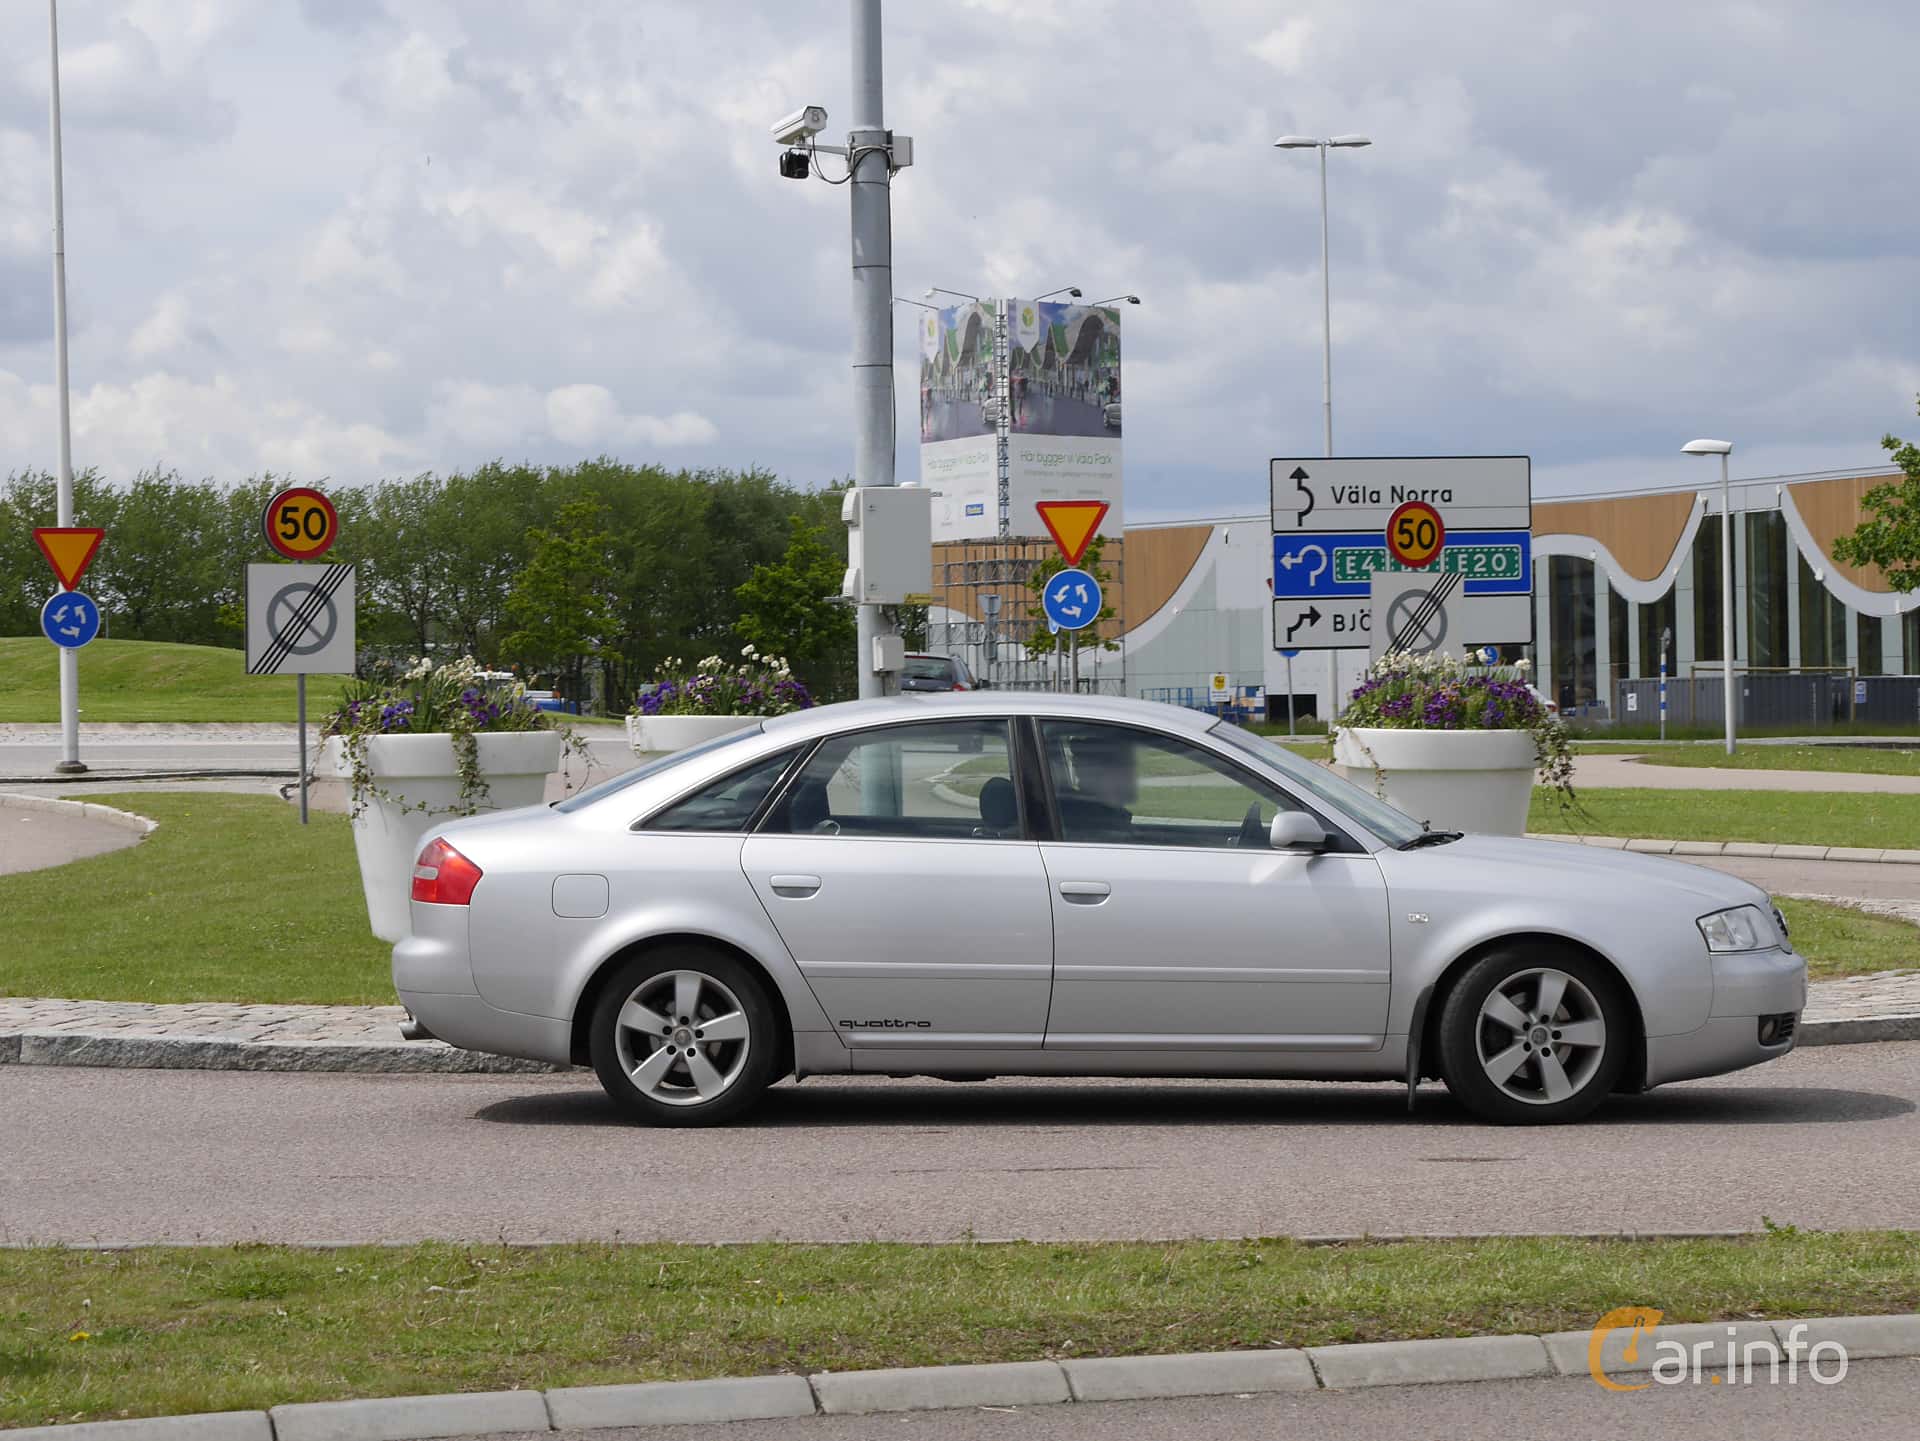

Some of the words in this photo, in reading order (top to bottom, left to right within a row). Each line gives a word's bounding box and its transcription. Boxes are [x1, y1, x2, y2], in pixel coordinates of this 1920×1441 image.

[1330, 485, 1381, 504] Väla
[1391, 485, 1453, 504] Norra
[280, 506, 327, 541] 50
[1398, 518, 1436, 550] 50
[1346, 555, 1376, 575] E4
[1457, 552, 1508, 573] E20
[839, 1019, 932, 1030] quattro
